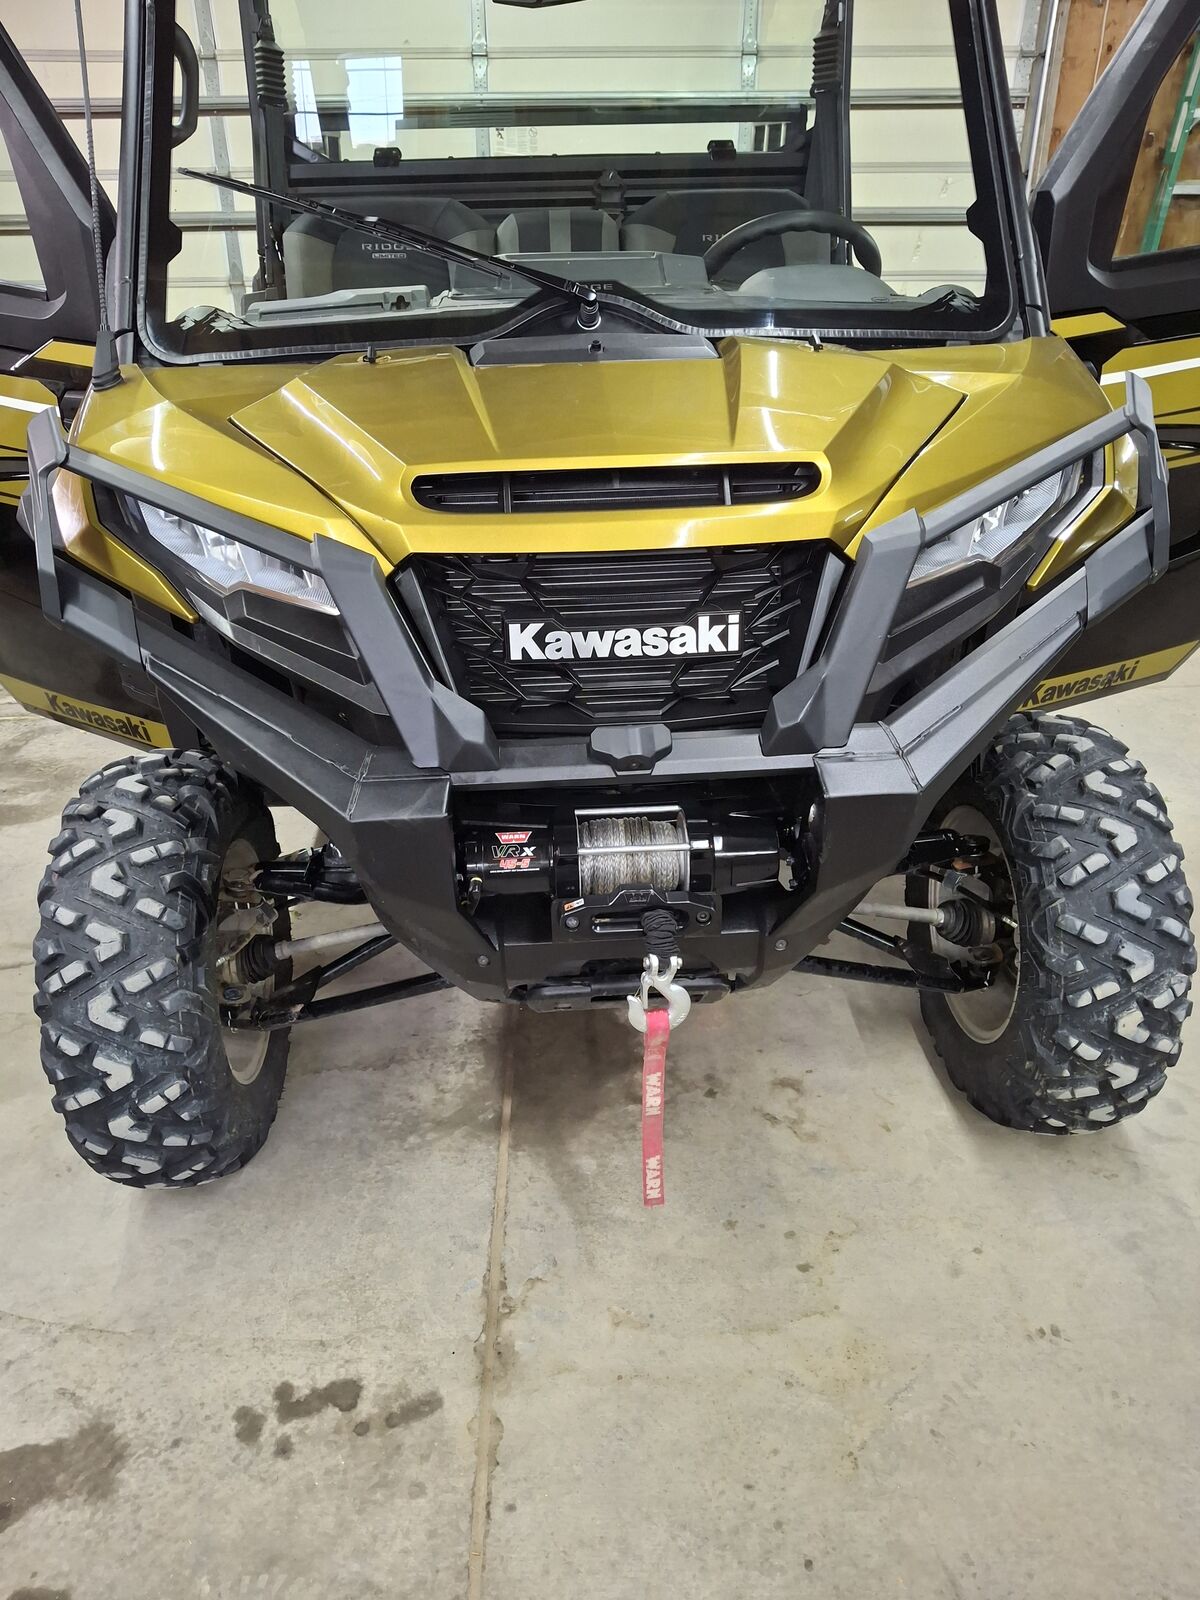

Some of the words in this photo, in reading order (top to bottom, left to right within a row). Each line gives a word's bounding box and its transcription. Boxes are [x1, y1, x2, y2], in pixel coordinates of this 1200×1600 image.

[508, 614, 740, 661] Kawasaki
[1021, 660, 1140, 708] Kawasaki
[44, 691, 152, 743] Kawasaki
[645, 1071, 662, 1116] WARN
[645, 1154, 662, 1200] WARN
